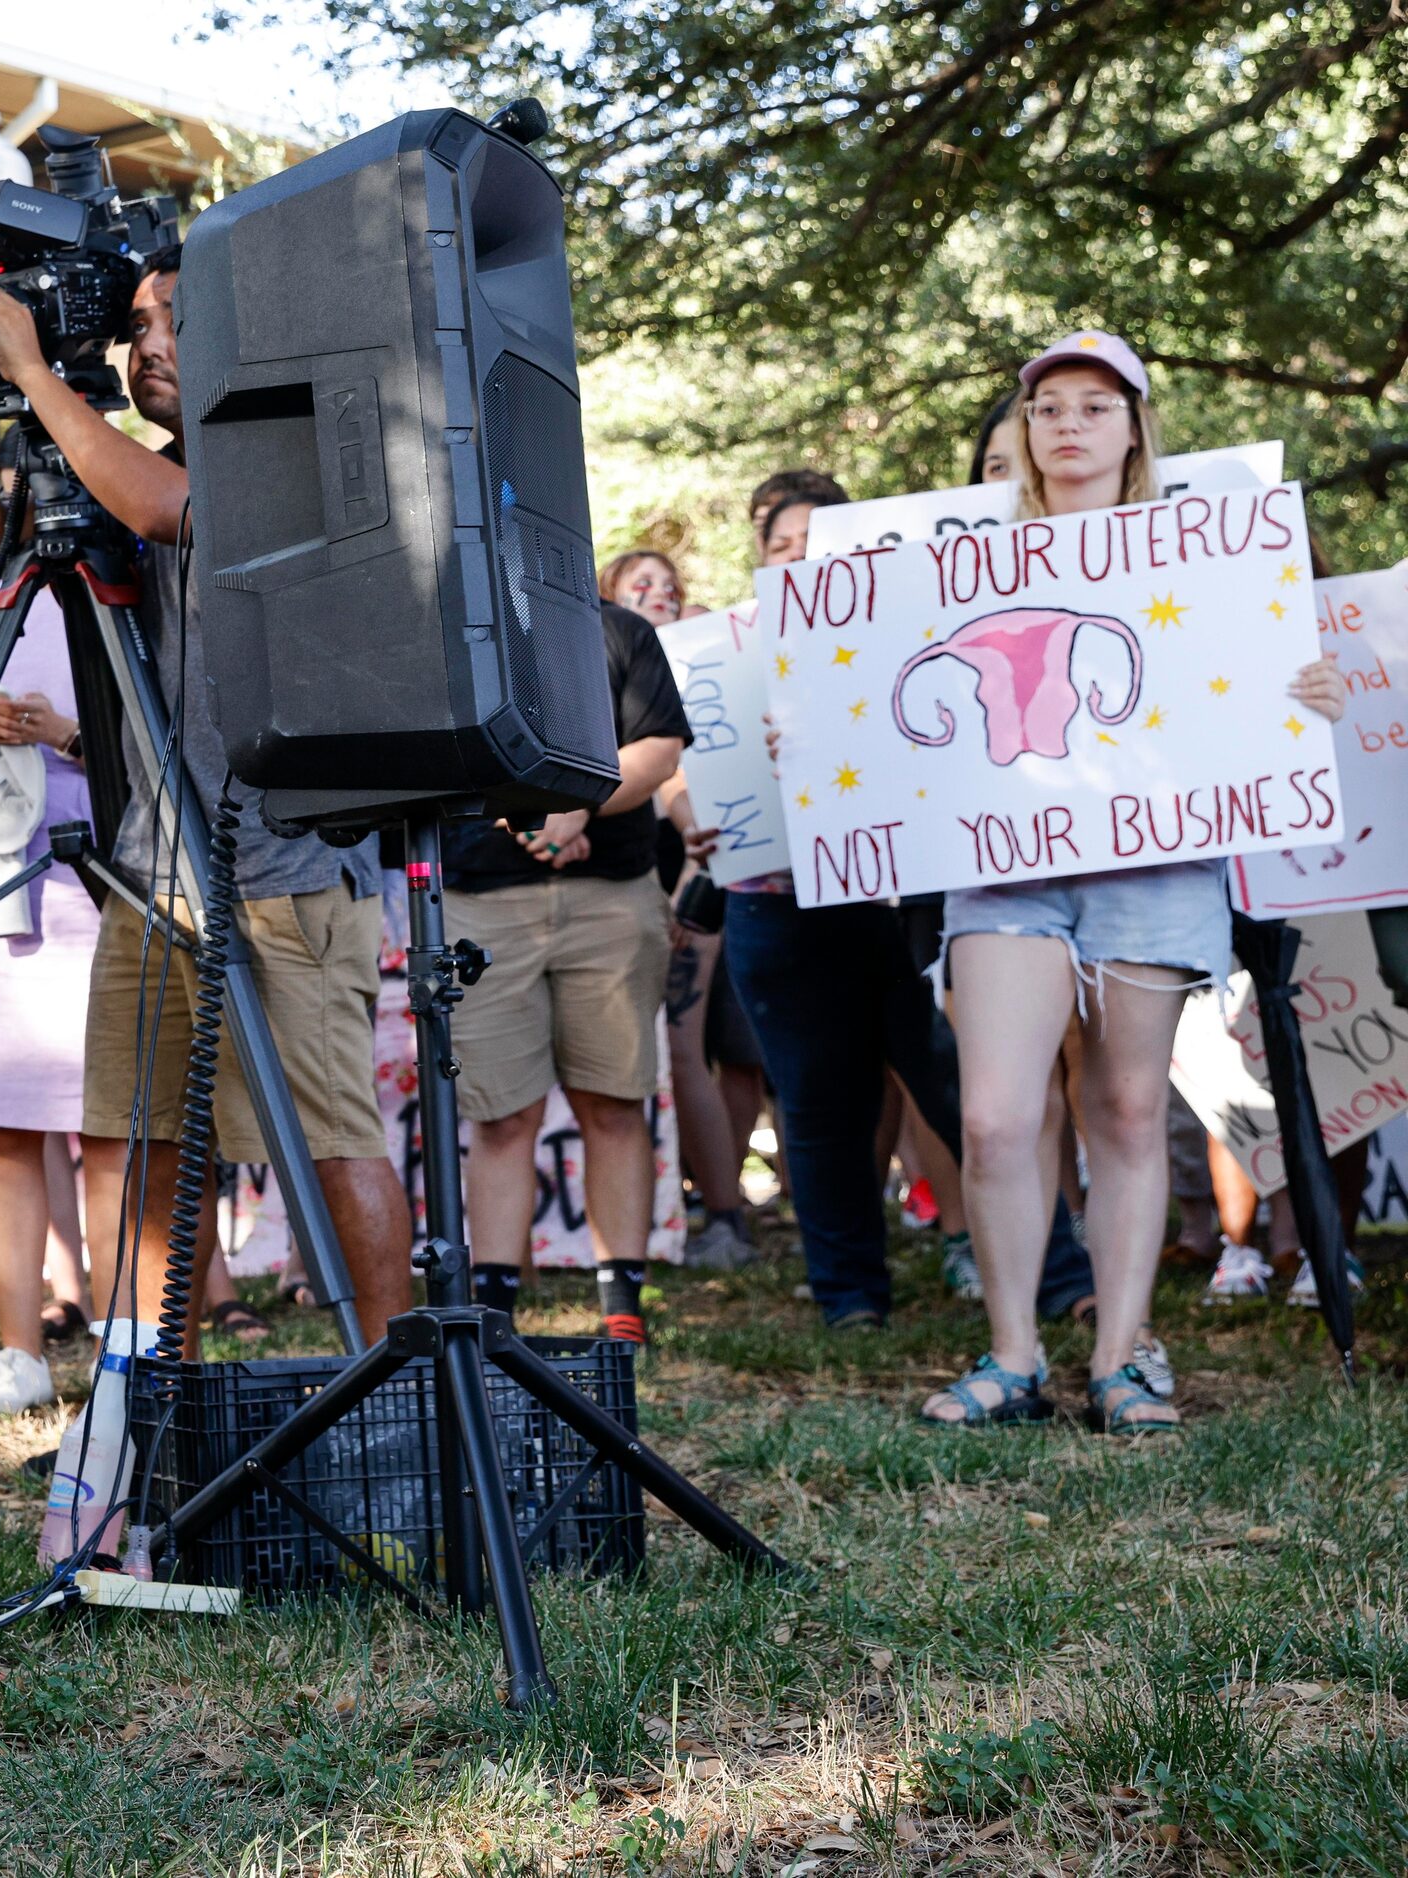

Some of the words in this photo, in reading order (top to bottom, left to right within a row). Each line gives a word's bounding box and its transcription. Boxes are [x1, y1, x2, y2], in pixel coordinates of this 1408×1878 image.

[11, 200, 43, 215] SONY
[779, 547, 896, 639] NOT
[926, 523, 1059, 608] YOUR
[1081, 488, 1293, 582] UTERUS
[679, 658, 740, 754] BODY
[713, 794, 774, 851] MY
[813, 821, 903, 903] NOT
[958, 806, 1081, 875] YOUR
[1110, 768, 1335, 858] BUSINESS
